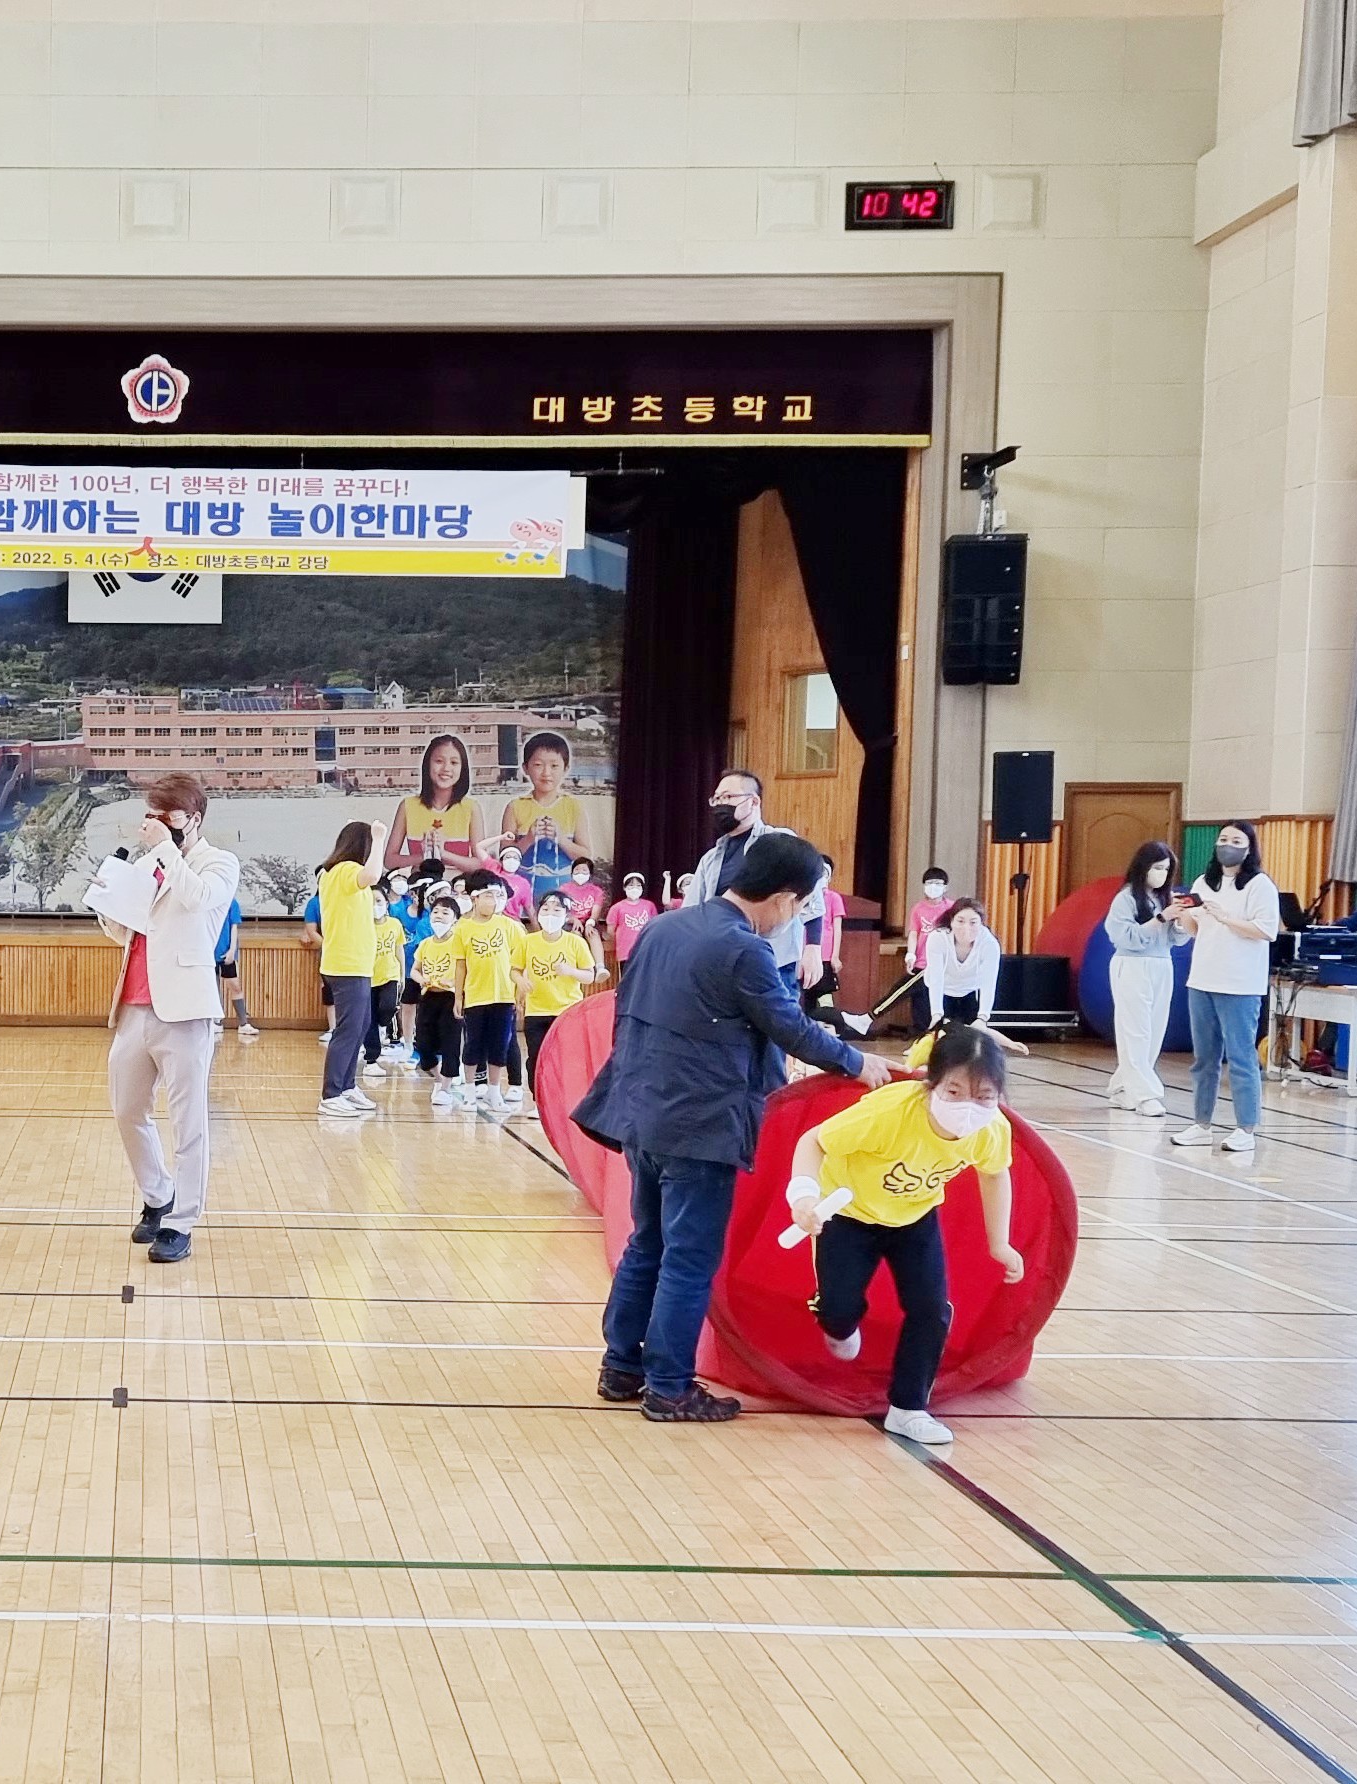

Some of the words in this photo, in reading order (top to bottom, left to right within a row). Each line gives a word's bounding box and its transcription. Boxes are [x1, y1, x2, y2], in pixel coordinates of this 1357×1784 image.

[862, 192, 889, 217] 10
[902, 190, 937, 218] 42
[533, 395, 813, 423] 대방초등학교
[69, 474, 140, 494] 100년,
[150, 475, 170, 495] 더
[181, 476, 248, 496] 행복한
[257, 477, 324, 497] 미래를
[332, 478, 410, 498] 꿈꾸다!
[165, 501, 245, 536] 대방
[267, 502, 473, 540] 놀이한마당
[12, 552, 57, 566] 2022.
[196, 555, 291, 569] 대방초등학교
[297, 556, 329, 570] 강당
